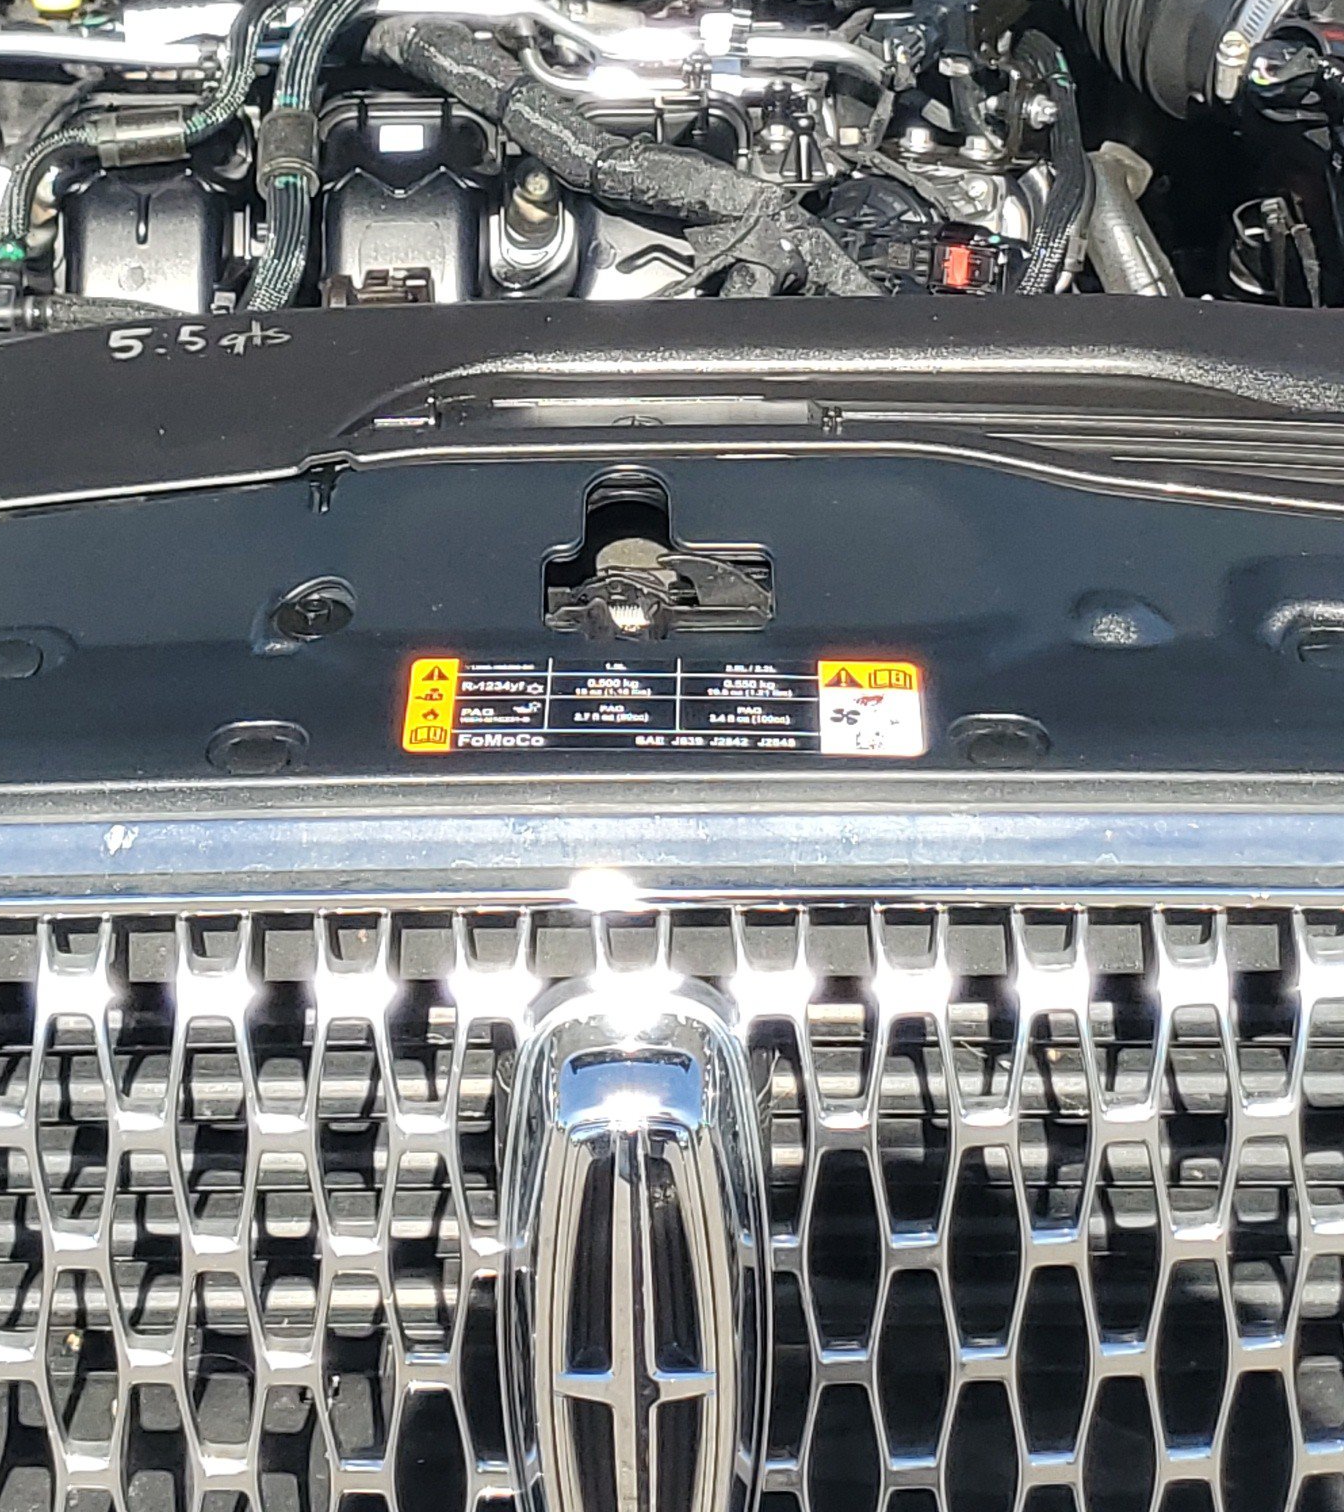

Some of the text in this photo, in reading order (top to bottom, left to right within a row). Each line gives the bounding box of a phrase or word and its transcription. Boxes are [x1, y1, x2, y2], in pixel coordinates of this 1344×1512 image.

[218, 320, 292, 355] qts
[461, 681, 526, 693] R-1234yf
[623, 678, 640, 690] kg
[759, 679, 776, 691] kg
[460, 708, 494, 716] PAG
[457, 733, 545, 748] FoMoCo
